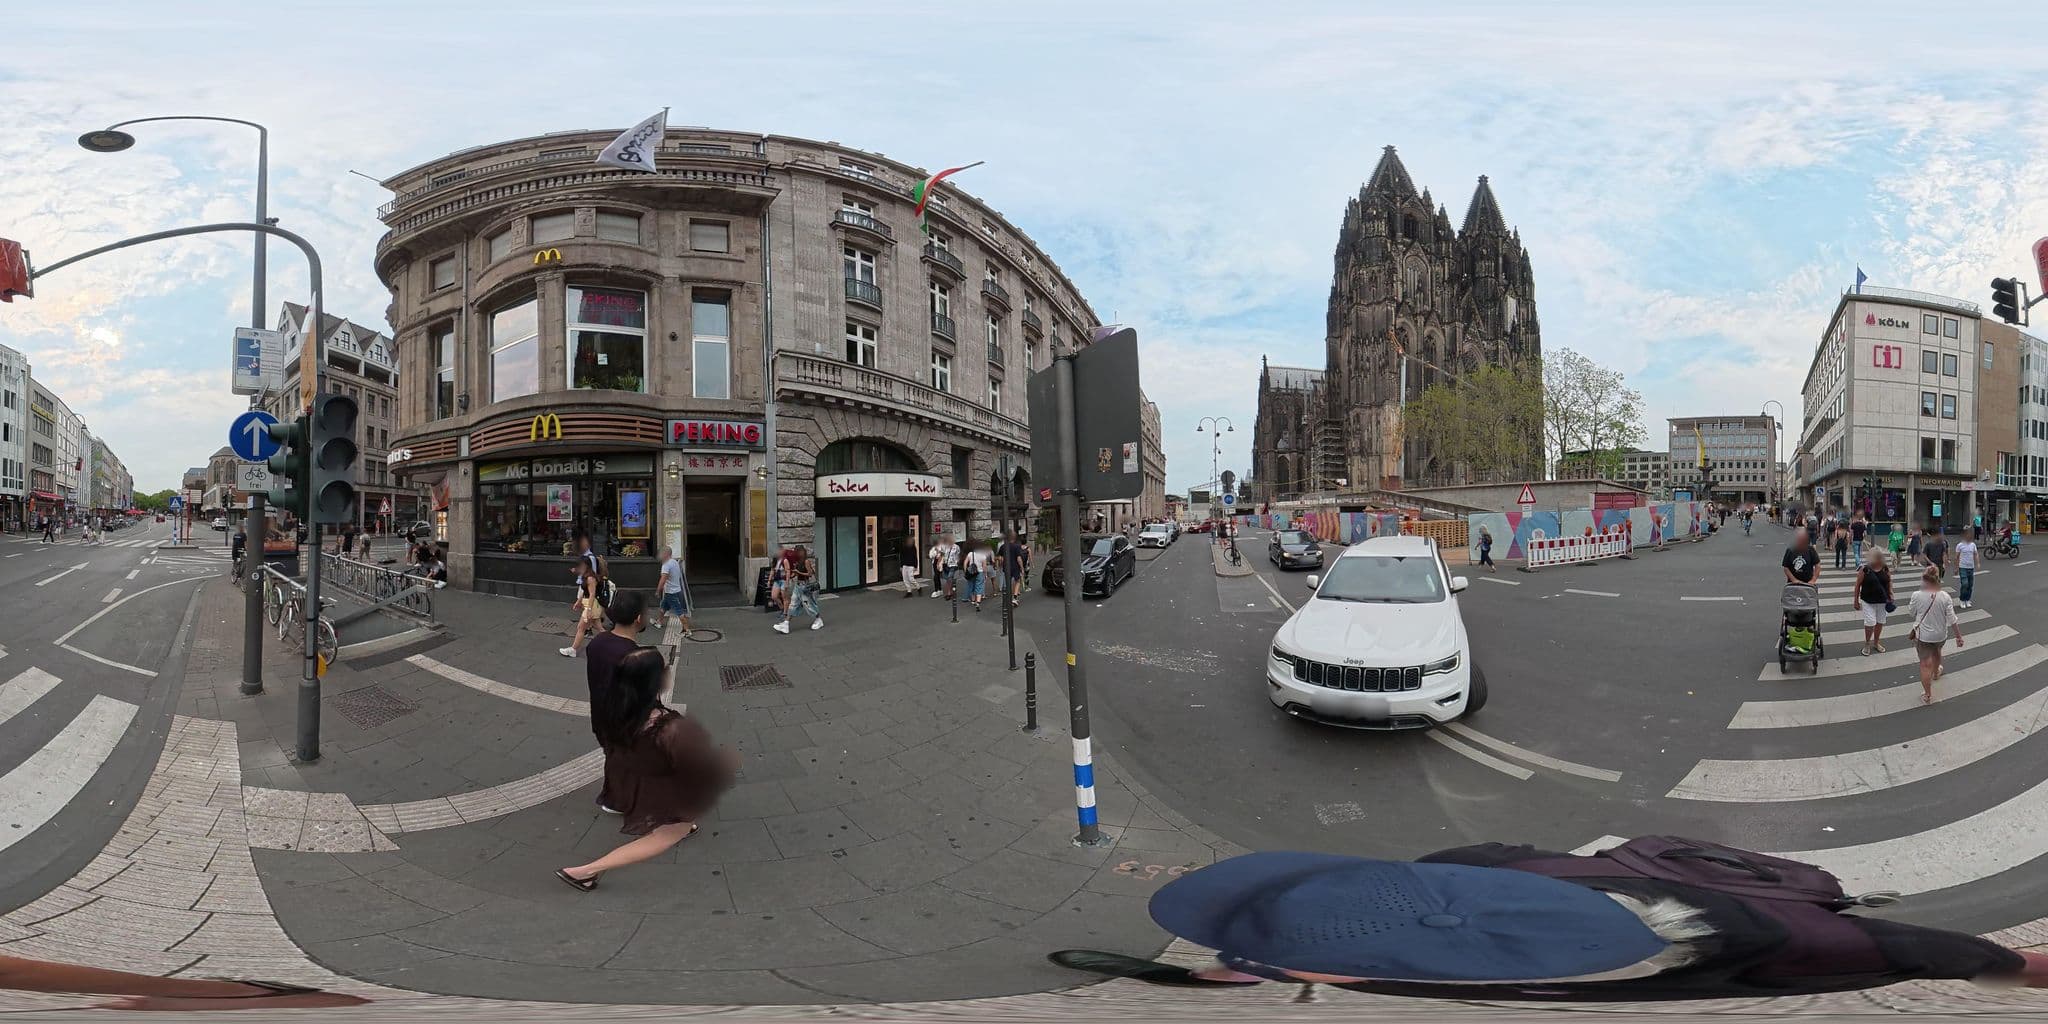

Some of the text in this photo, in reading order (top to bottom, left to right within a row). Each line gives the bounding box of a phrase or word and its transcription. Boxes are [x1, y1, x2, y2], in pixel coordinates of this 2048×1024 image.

[1878, 317, 1910, 329] KÖLN
[673, 422, 760, 443] PEKING
[249, 481, 262, 489] frei
[828, 478, 869, 494] taku
[905, 477, 936, 493] taku
[1920, 478, 1961, 488] INFORMATIO
[1343, 657, 1365, 666] Jeep
